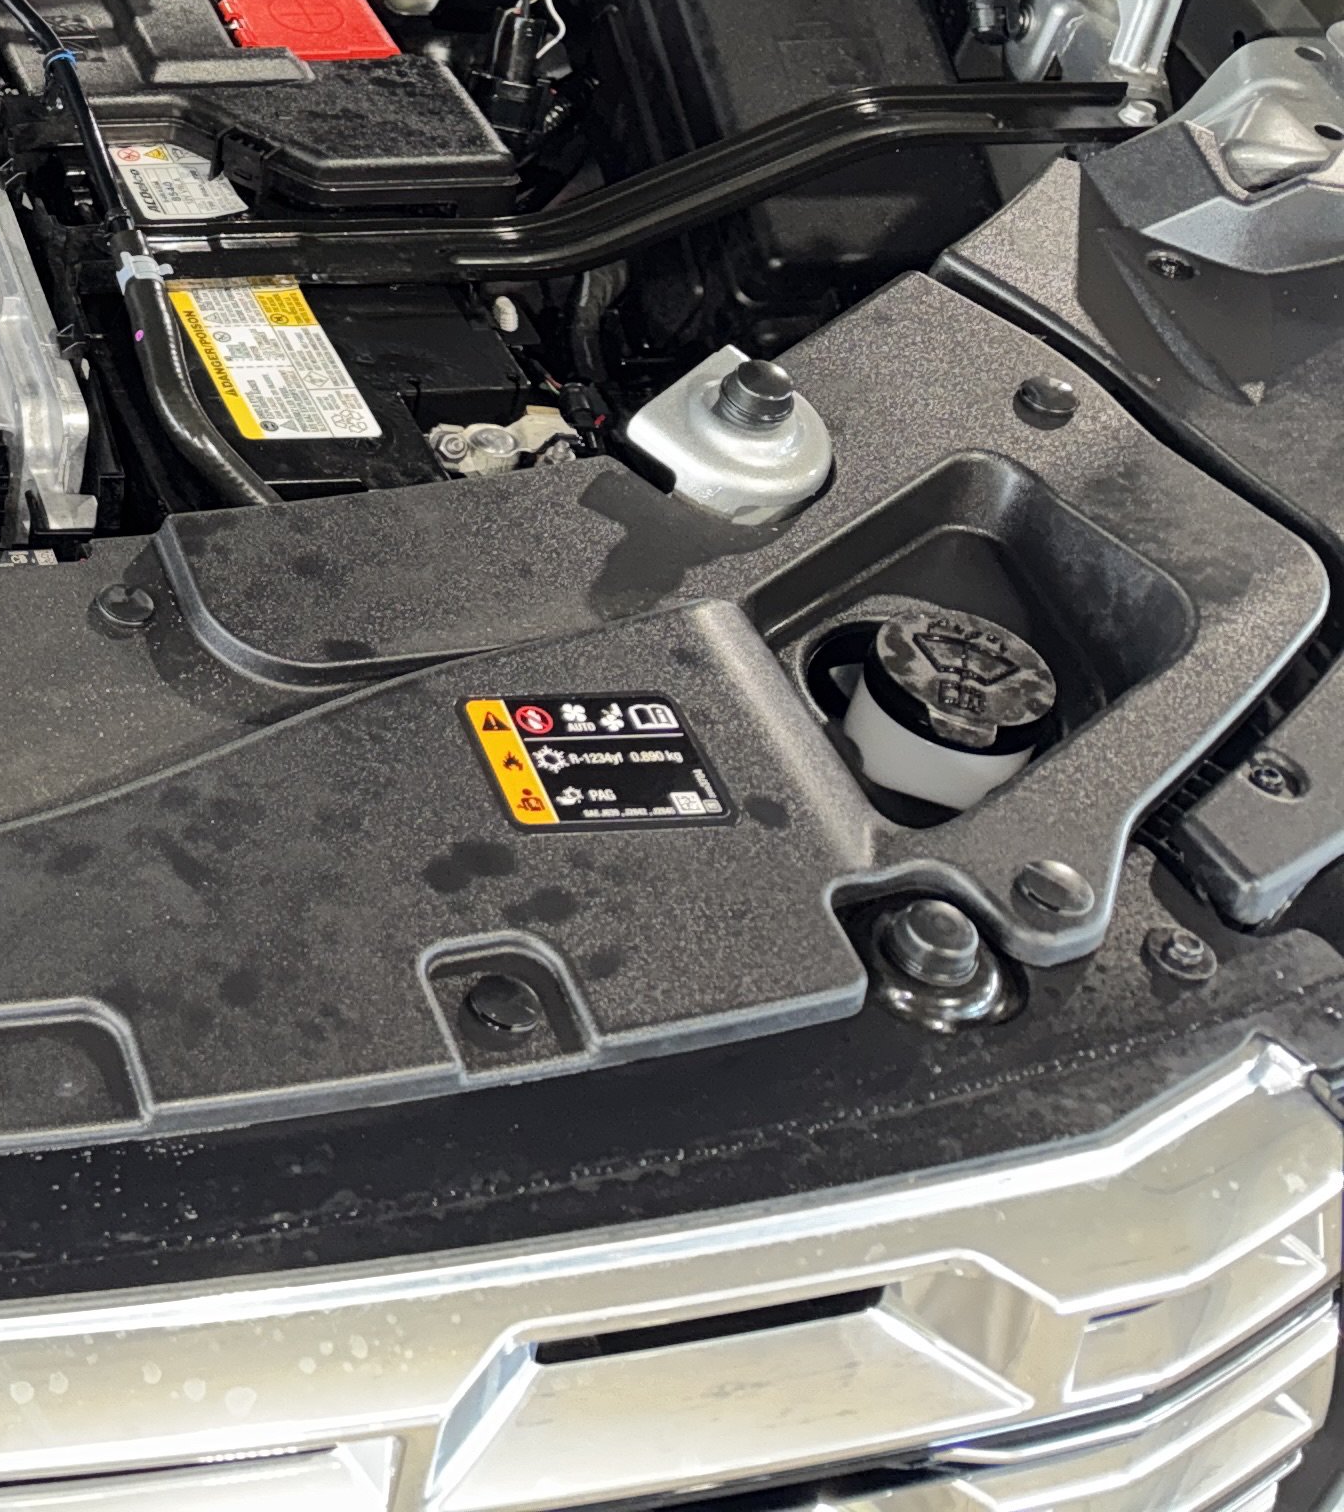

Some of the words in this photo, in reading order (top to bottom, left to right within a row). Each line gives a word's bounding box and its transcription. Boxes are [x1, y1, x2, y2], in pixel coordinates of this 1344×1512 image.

[130, 168, 161, 213] ACDelco
[183, 310, 235, 391] DANGER/POISON
[567, 721, 597, 733] AUTO
[665, 750, 684, 764] kg
[587, 788, 617, 802] PAG
